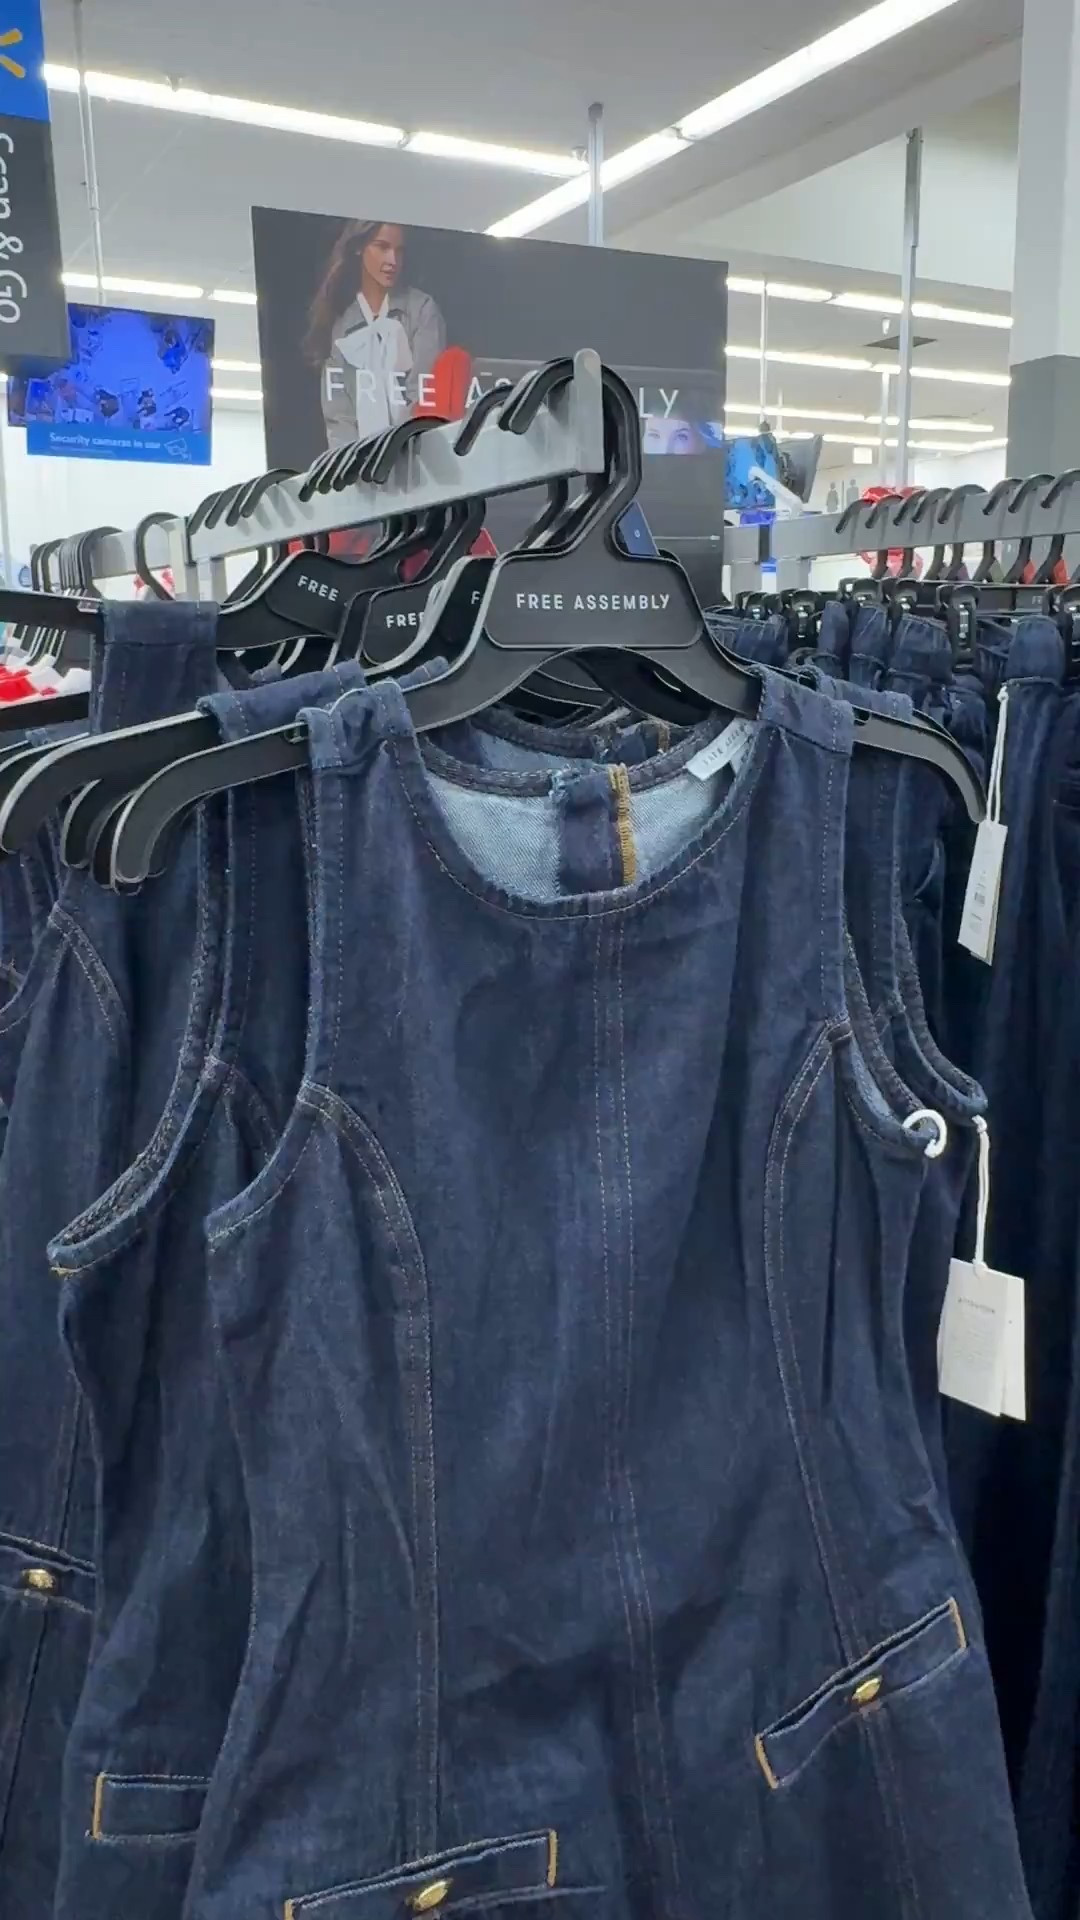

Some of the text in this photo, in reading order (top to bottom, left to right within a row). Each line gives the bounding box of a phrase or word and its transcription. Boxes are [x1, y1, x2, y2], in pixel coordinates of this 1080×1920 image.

[325, 367, 437, 408] FREE
[50, 432, 90, 446] Security
[297, 575, 340, 602] FREE
[516, 593, 670, 611] FREE ASSEMBLY
